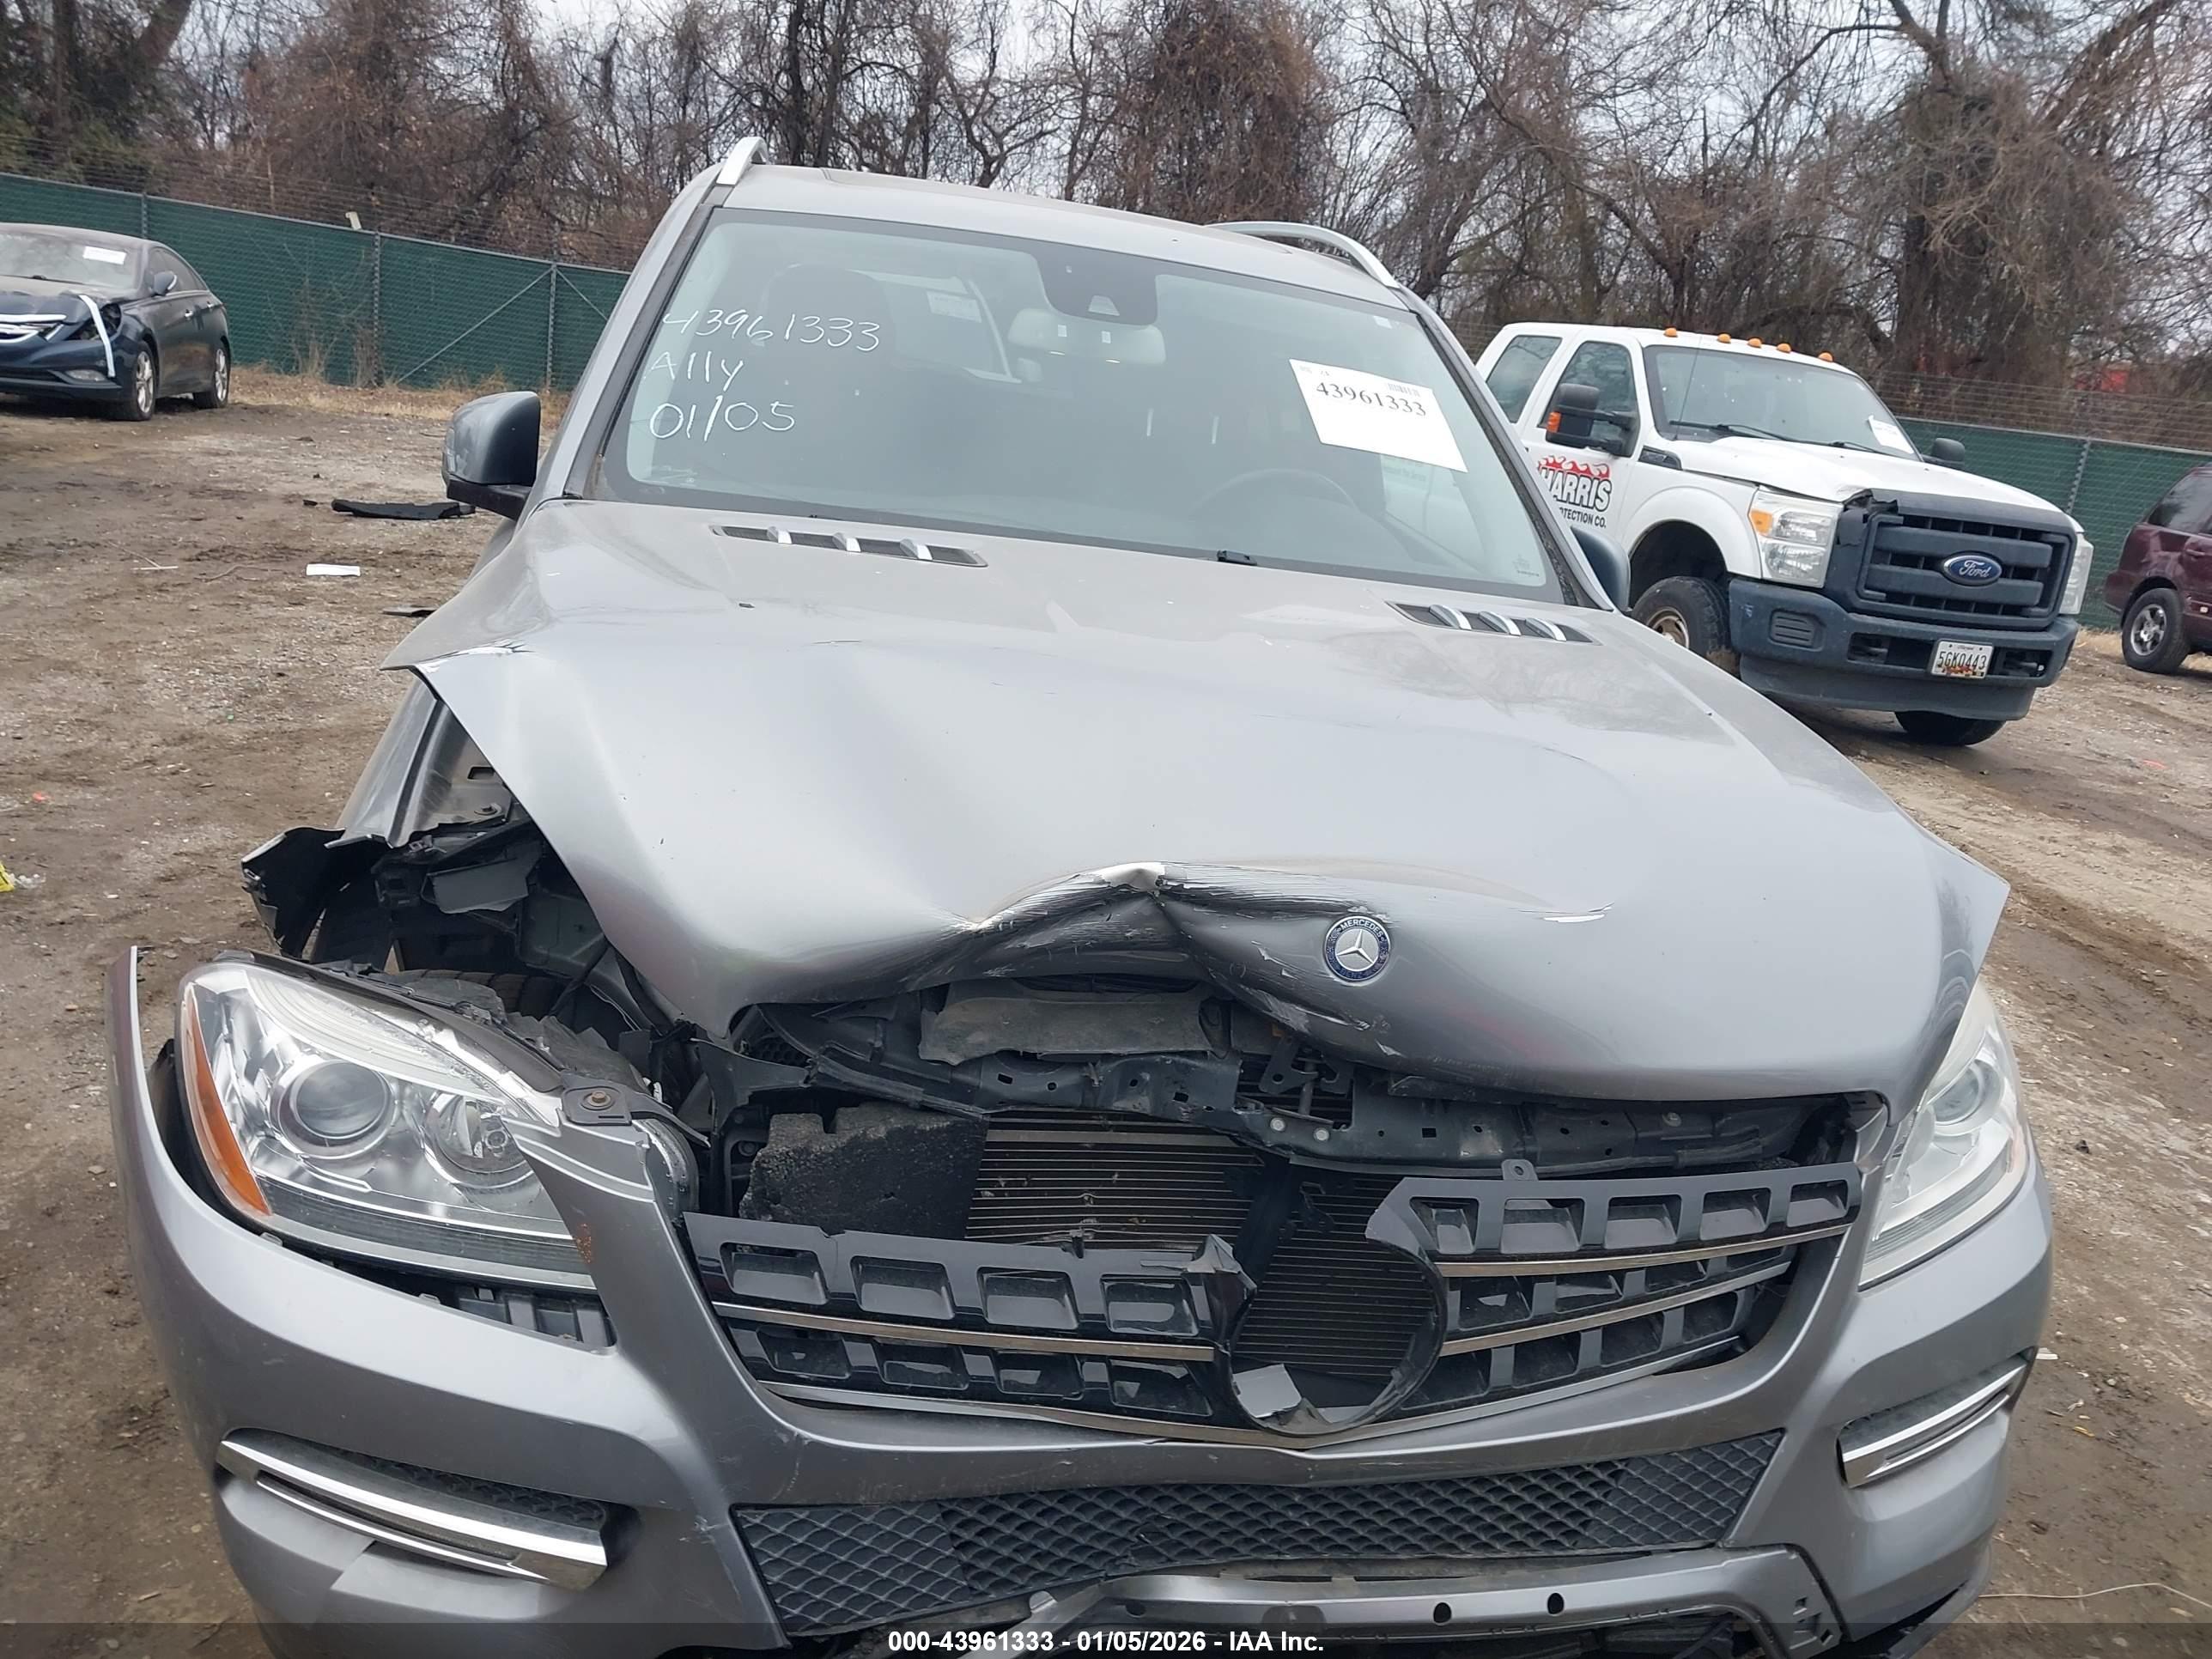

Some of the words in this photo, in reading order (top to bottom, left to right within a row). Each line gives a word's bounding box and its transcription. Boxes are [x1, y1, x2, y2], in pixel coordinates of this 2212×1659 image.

[662, 308, 881, 352] 43961333
[1316, 381, 1426, 416] 43961333
[649, 395, 795, 442] 01/05
[1594, 515, 1607, 528] CO.
[1959, 559, 1992, 578] Ford
[1340, 919, 1384, 938] MERCEDES
